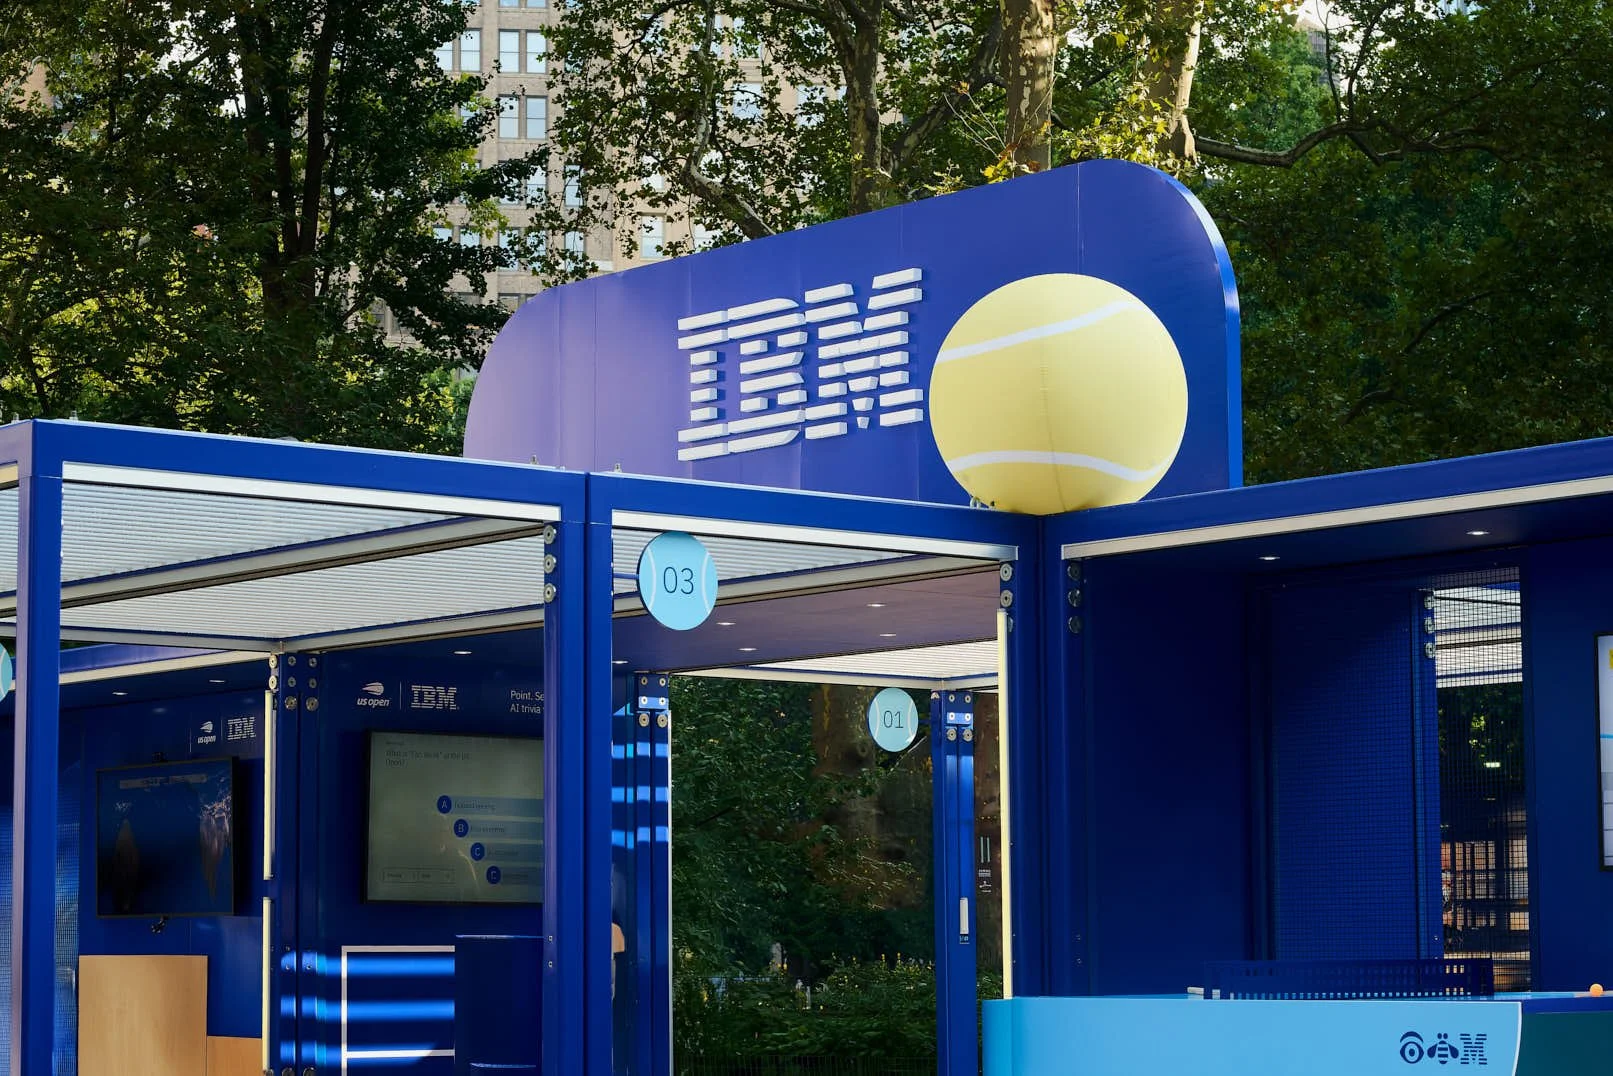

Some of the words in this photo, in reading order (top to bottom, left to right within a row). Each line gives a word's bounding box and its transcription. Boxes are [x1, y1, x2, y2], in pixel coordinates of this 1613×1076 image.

[677, 267, 924, 462] IBM
[663, 566, 694, 595] 03
[368, 698, 390, 709] open
[411, 685, 457, 710] IBM
[510, 703, 520, 713] AI
[521, 704, 541, 714] trivia
[883, 710, 904, 729] 01
[227, 716, 255, 740] IBM
[441, 800, 448, 809] A
[458, 823, 465, 833] B
[474, 847, 481, 857] C
